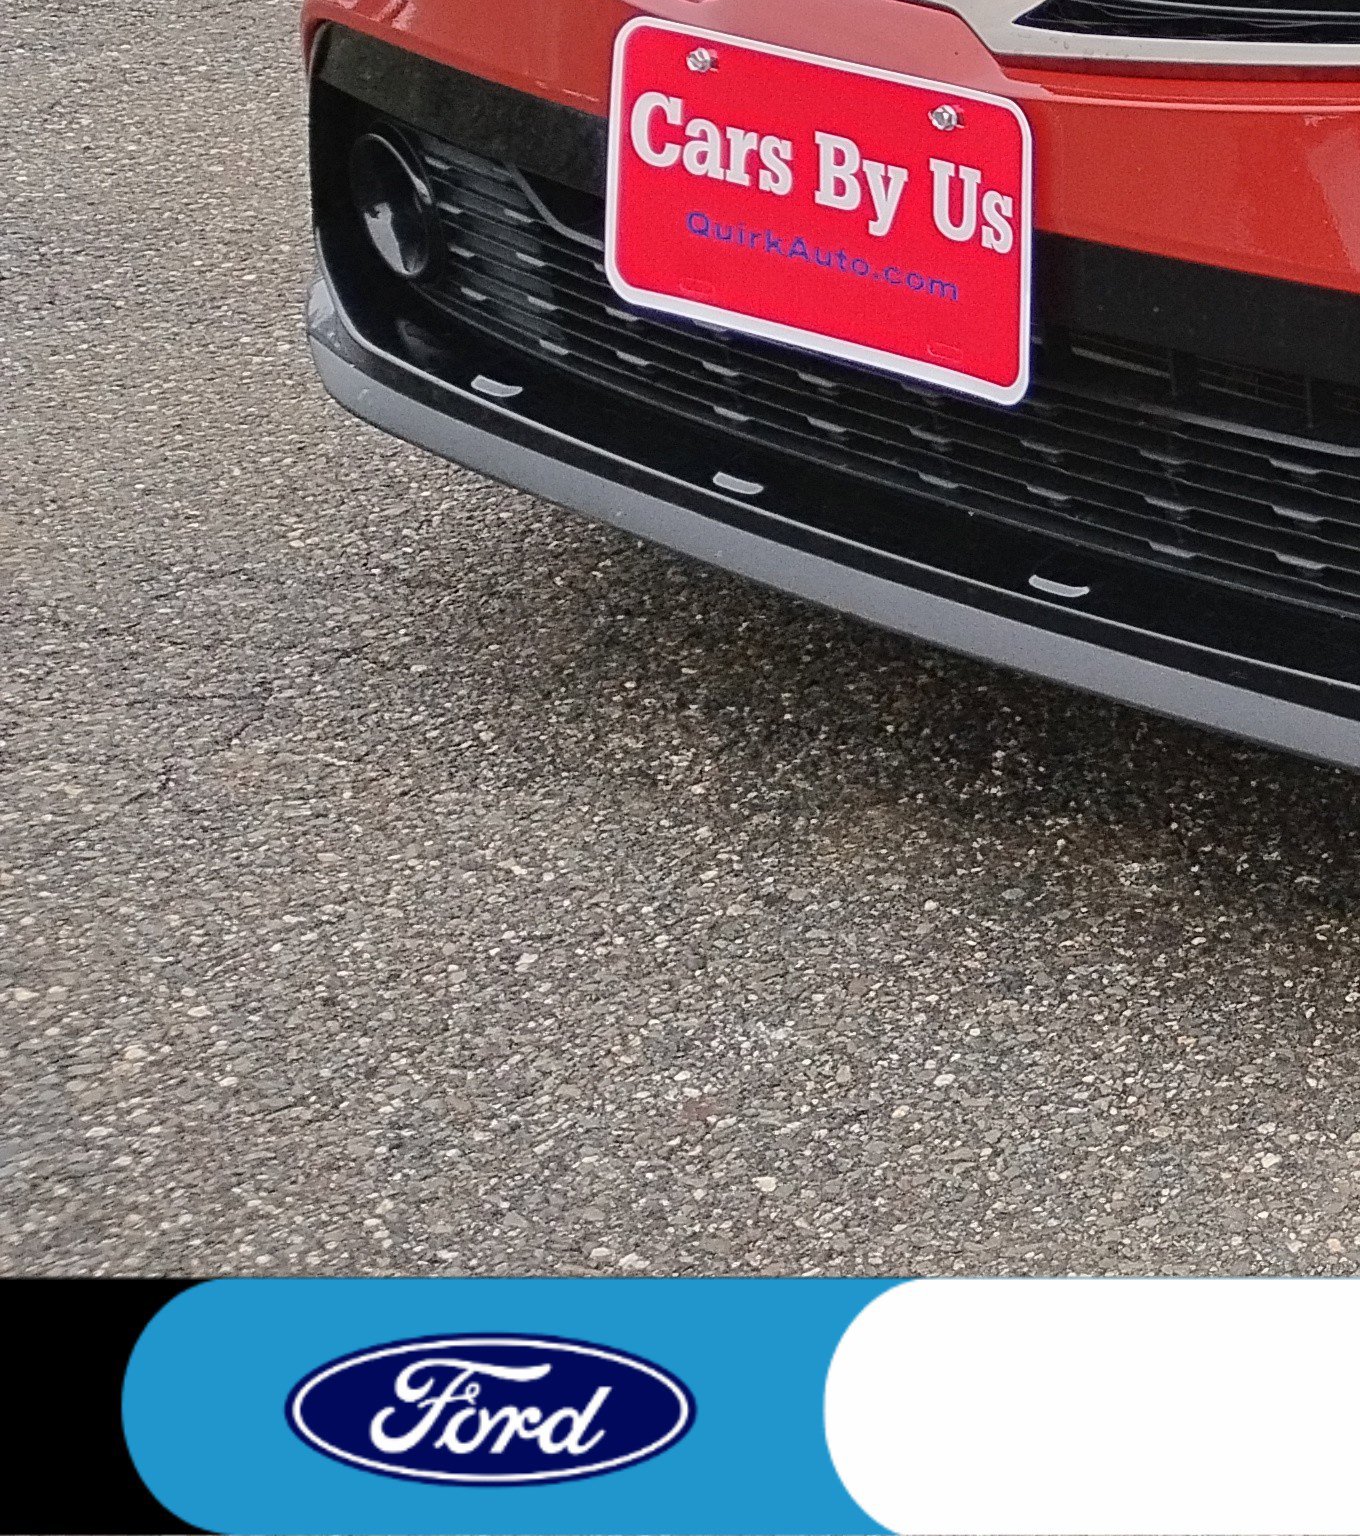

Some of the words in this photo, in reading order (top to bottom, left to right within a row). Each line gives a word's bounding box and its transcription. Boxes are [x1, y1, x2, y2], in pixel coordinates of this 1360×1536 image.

[629, 90, 794, 196] Cars
[813, 130, 909, 238] By
[928, 156, 1015, 255] Us
[685, 209, 960, 302] QuirkAuto.com
